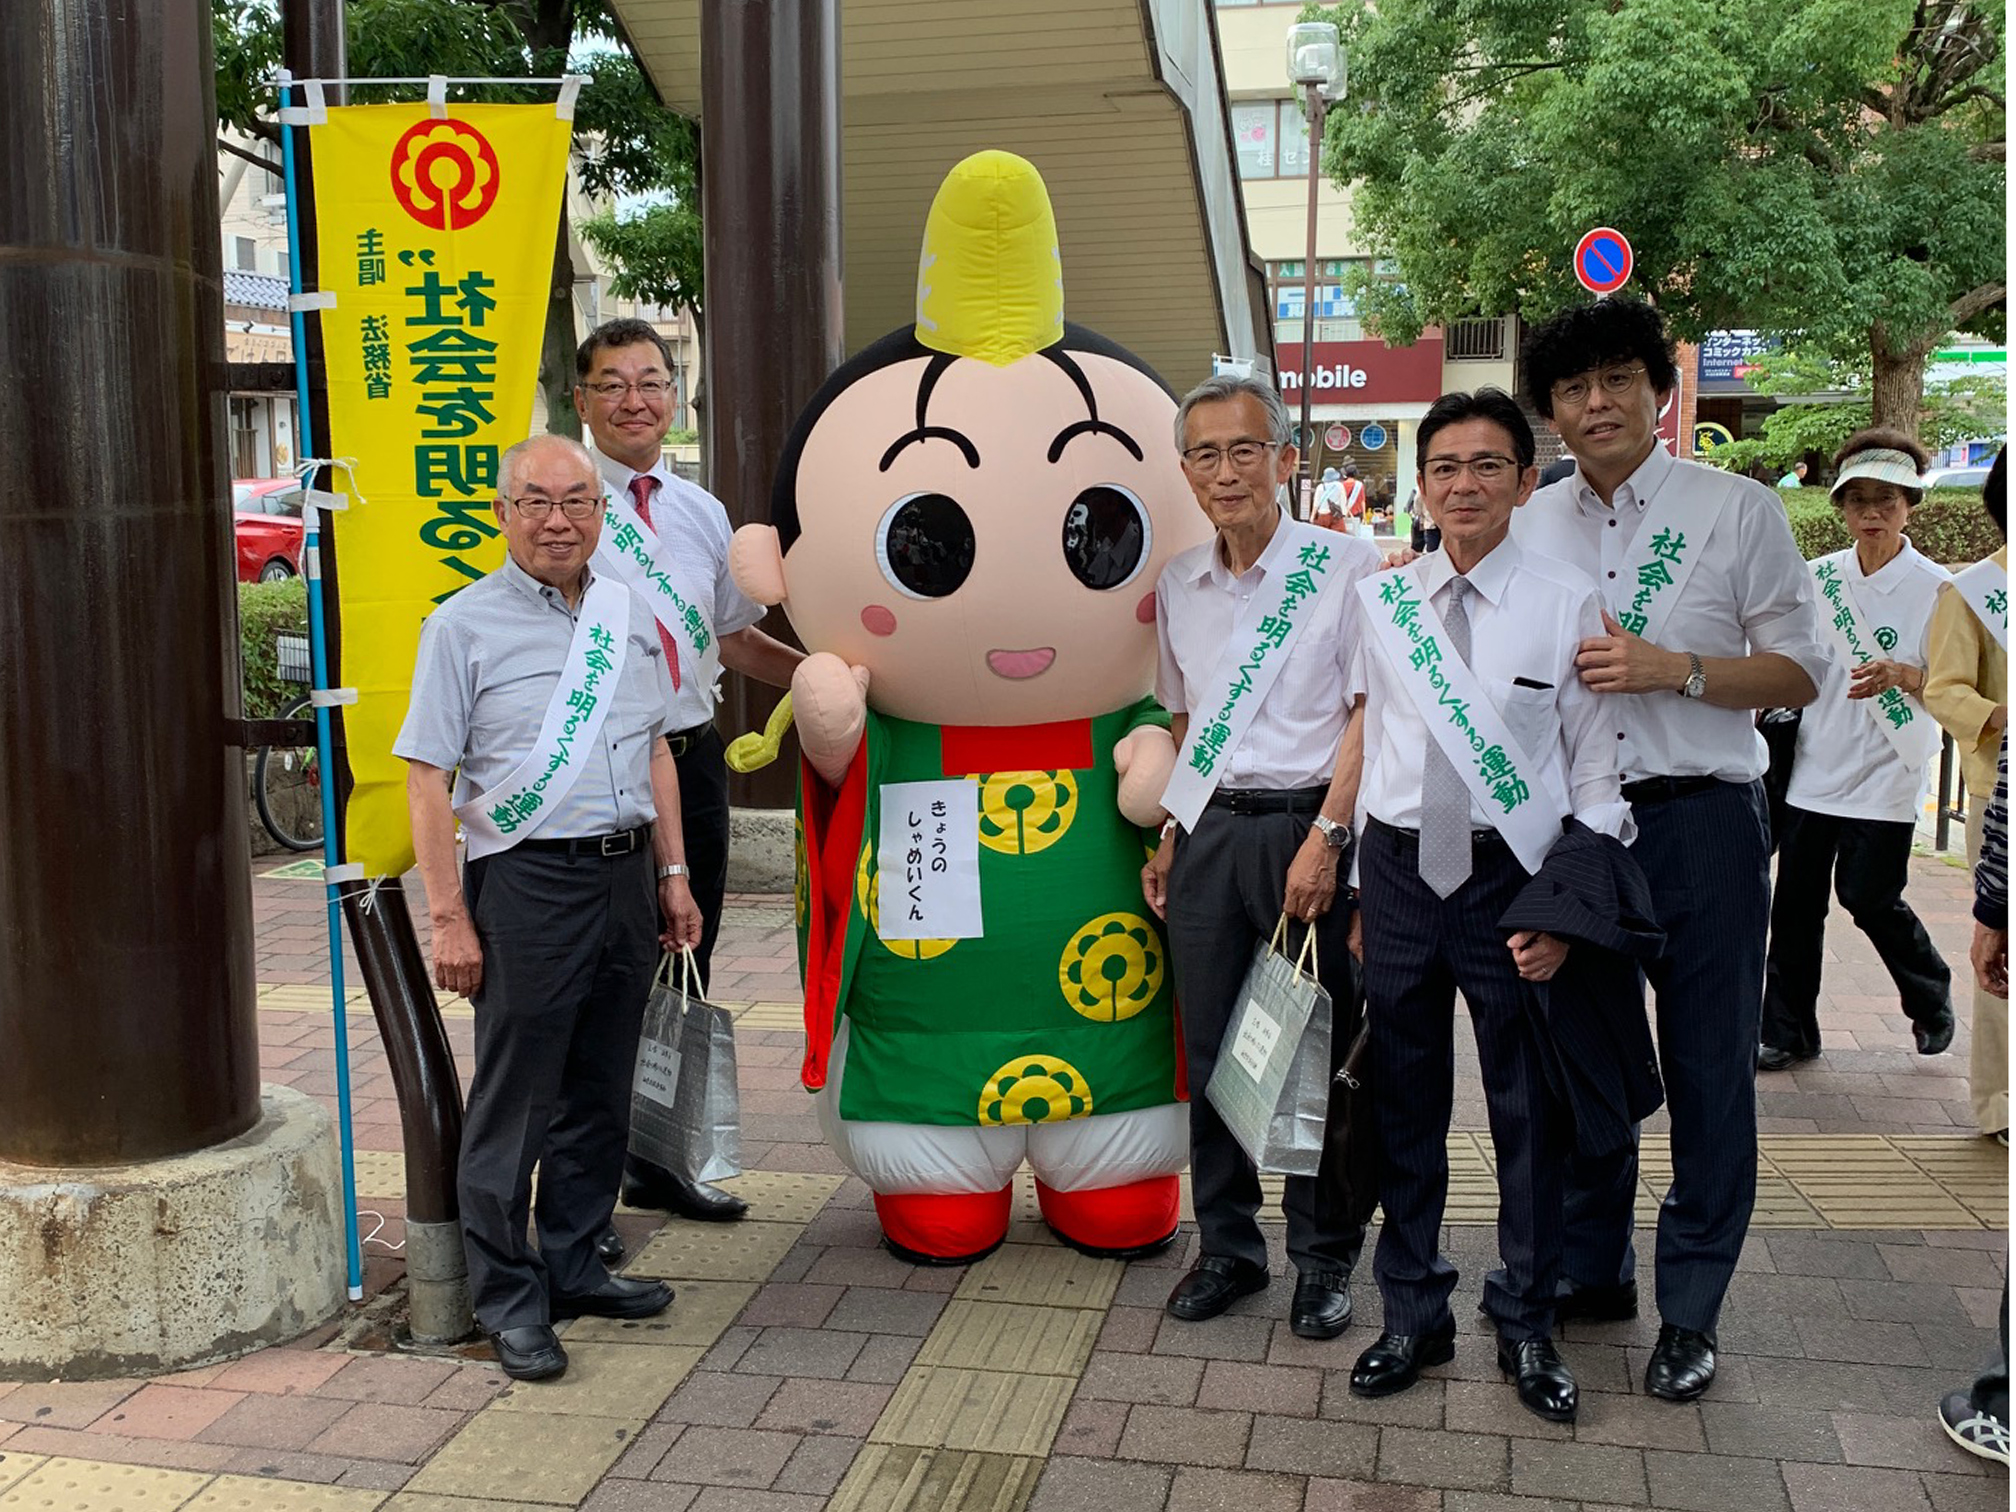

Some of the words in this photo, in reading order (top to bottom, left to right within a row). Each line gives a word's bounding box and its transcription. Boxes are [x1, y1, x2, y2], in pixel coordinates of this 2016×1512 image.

[1703, 358, 1743, 367] Internet
[487, 623, 615, 834] 社会を明るくする運動
[1189, 541, 1331, 778] 社会を明るくする運動
[1378, 574, 1530, 814] 社会を明るくする運動
[906, 811, 924, 921] しゃめいくん
[931, 800, 947, 873] きょうの
